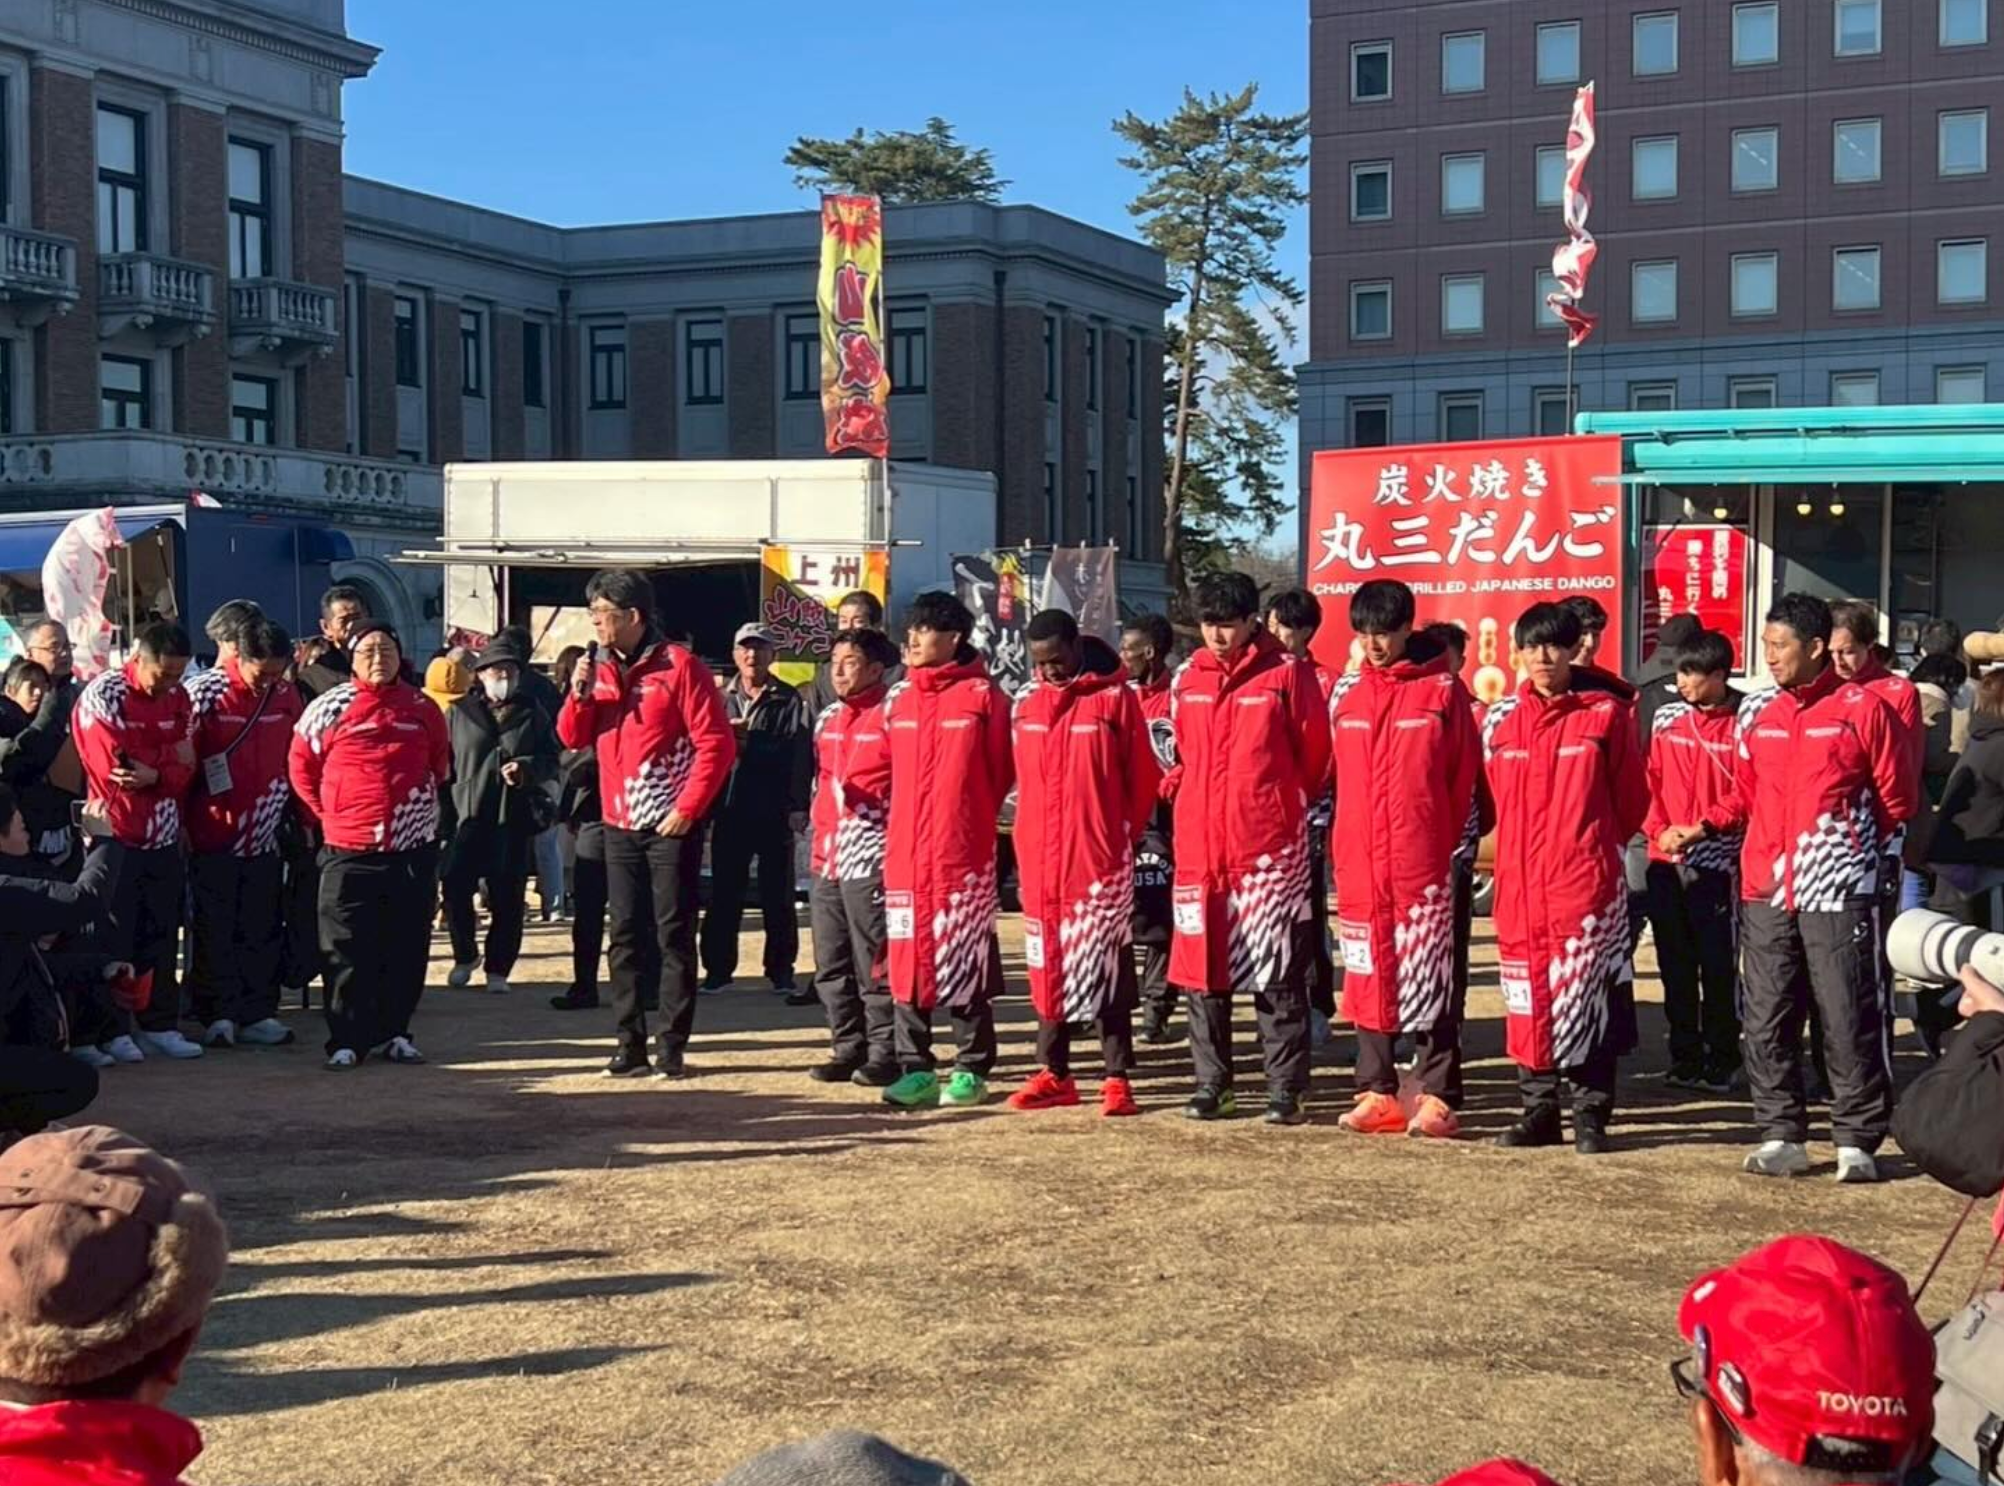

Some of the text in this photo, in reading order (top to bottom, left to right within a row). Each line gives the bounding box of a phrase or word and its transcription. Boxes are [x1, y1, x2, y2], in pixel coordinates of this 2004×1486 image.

[1373, 458, 1548, 506] 炭火焼き
[1313, 506, 1617, 571] 丸三だんご
[790, 555, 861, 588] 上州
[1471, 577, 1553, 593] JAPANESE
[1558, 575, 1616, 590] DANGO
[1134, 871, 1167, 887] USA
[1816, 1390, 1908, 1417] TOYOTA
